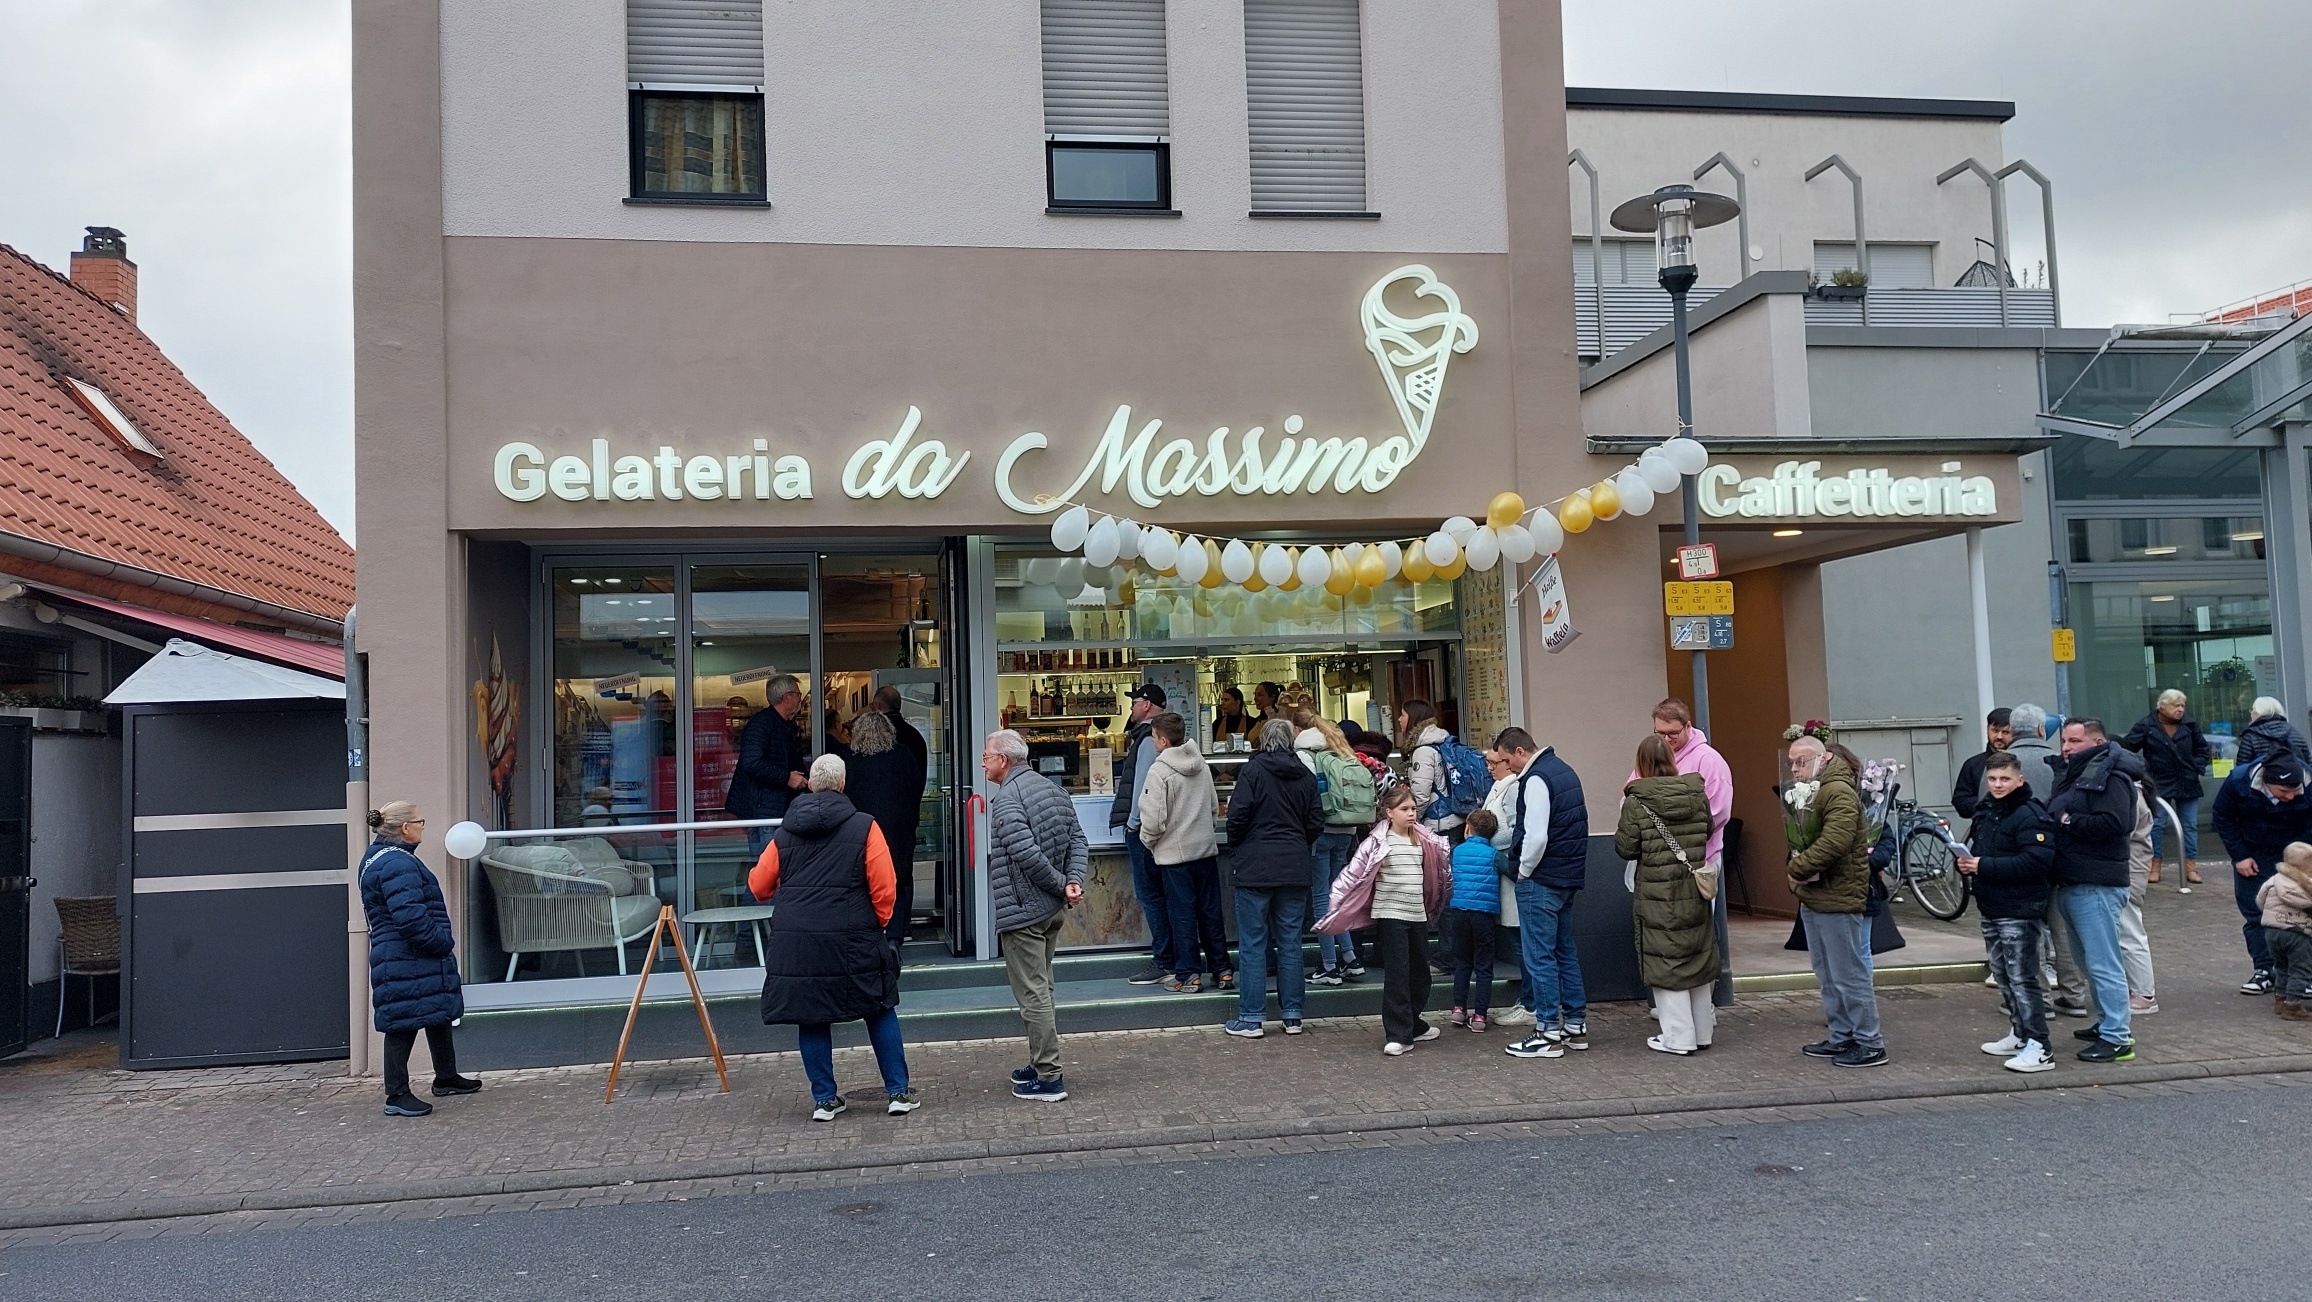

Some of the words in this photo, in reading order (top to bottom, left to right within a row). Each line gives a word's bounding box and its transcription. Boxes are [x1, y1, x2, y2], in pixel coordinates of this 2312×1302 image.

[494, 438, 814, 501] Gelateria
[841, 405, 971, 499] da
[995, 404, 1410, 514] Massimo
[1699, 460, 1997, 517] Caffetteria
[1545, 622, 1569, 648] Waffeln
